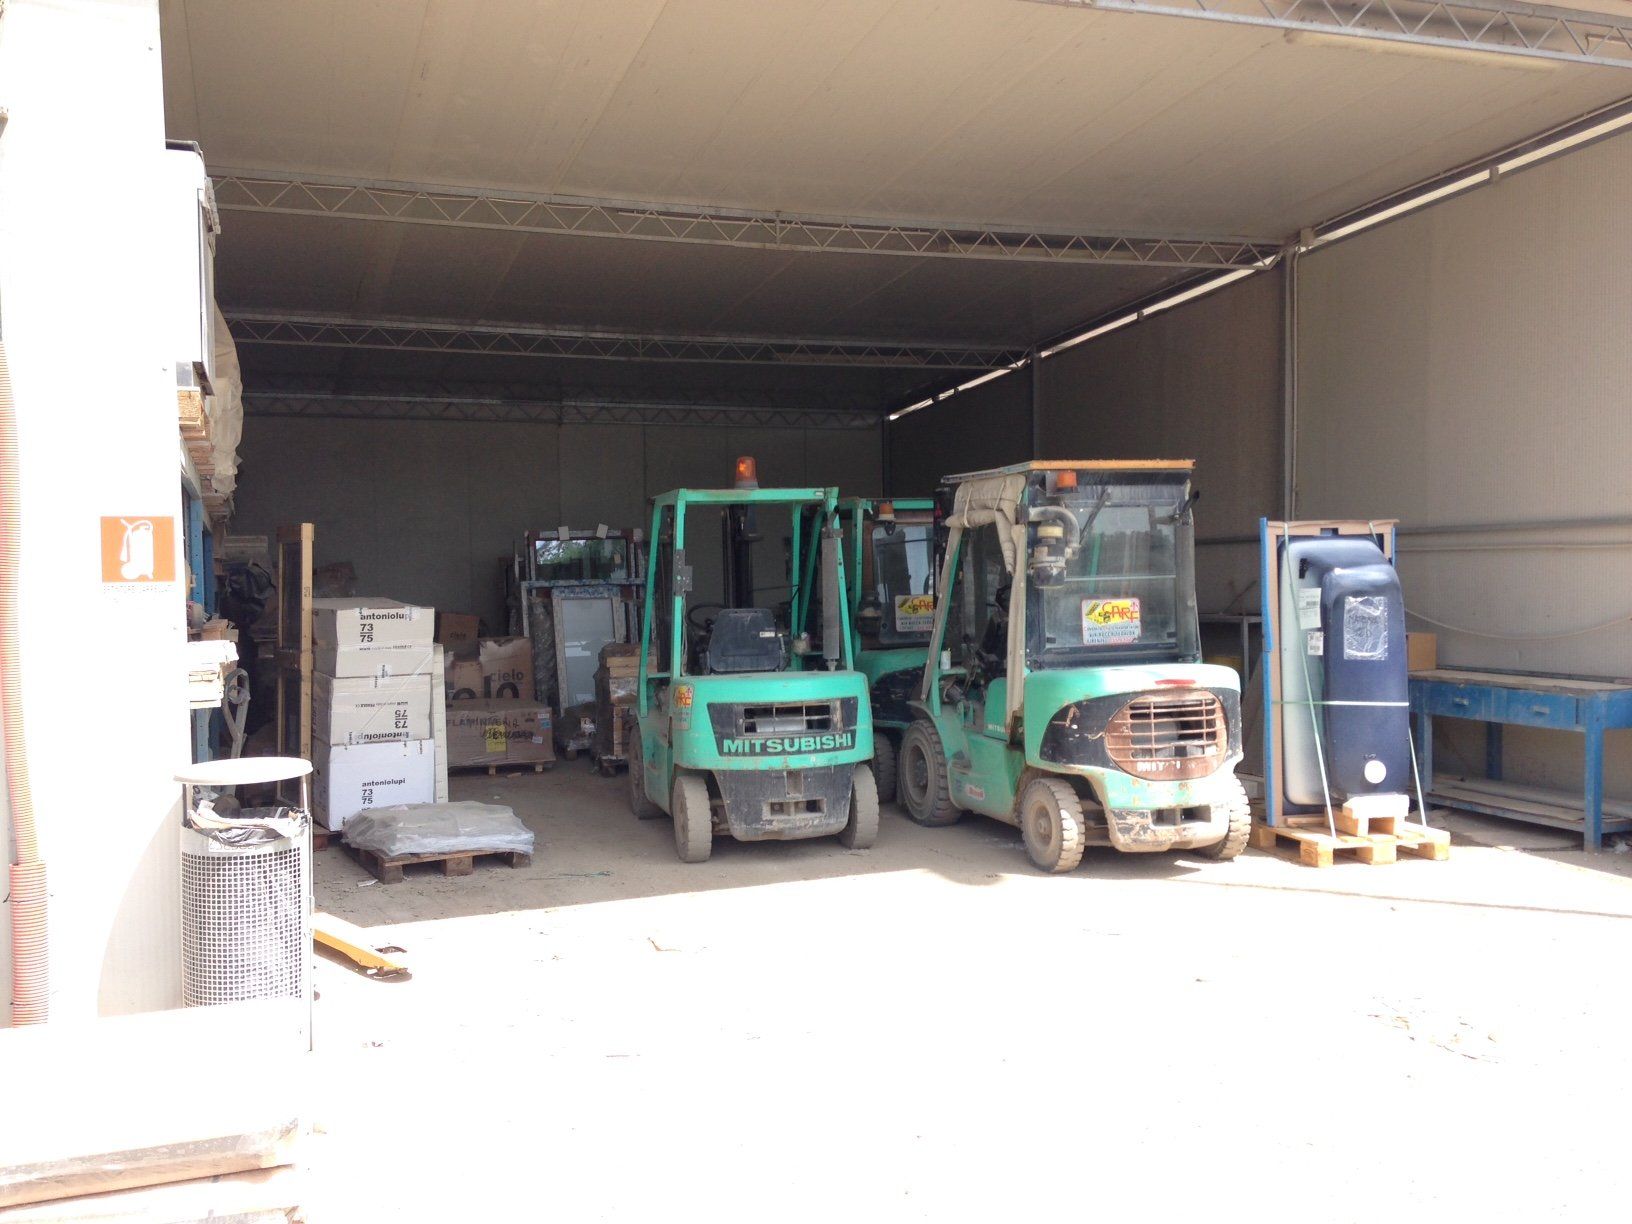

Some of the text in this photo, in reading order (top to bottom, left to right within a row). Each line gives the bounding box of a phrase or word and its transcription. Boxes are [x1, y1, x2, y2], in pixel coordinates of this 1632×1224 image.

[360, 611, 412, 621] antoniolup
[360, 623, 374, 631] 73
[360, 634, 374, 642] 75
[489, 668, 524, 682] cielo
[394, 709, 408, 718] 75
[394, 720, 408, 729] 73
[723, 733, 852, 753] MITSUBISHI
[361, 777, 406, 787] antoniolupi
[361, 788, 373, 796] 73
[361, 797, 373, 805] 75
